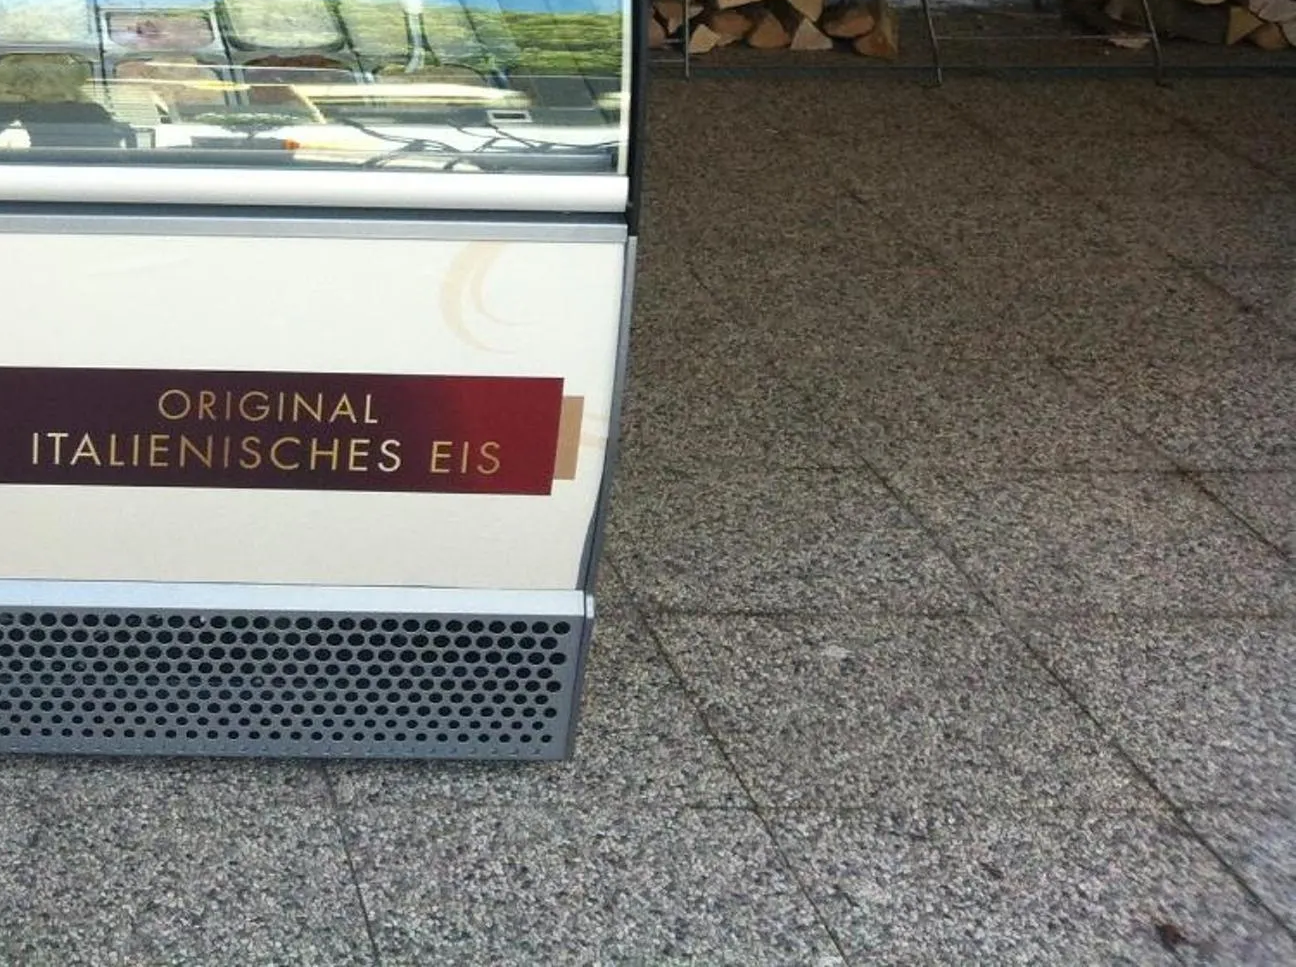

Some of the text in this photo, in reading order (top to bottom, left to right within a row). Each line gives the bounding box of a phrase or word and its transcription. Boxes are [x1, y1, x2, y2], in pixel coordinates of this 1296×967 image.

[157, 388, 379, 424] ORIGINAL
[30, 431, 502, 475] ITALIENISCHES EIS
